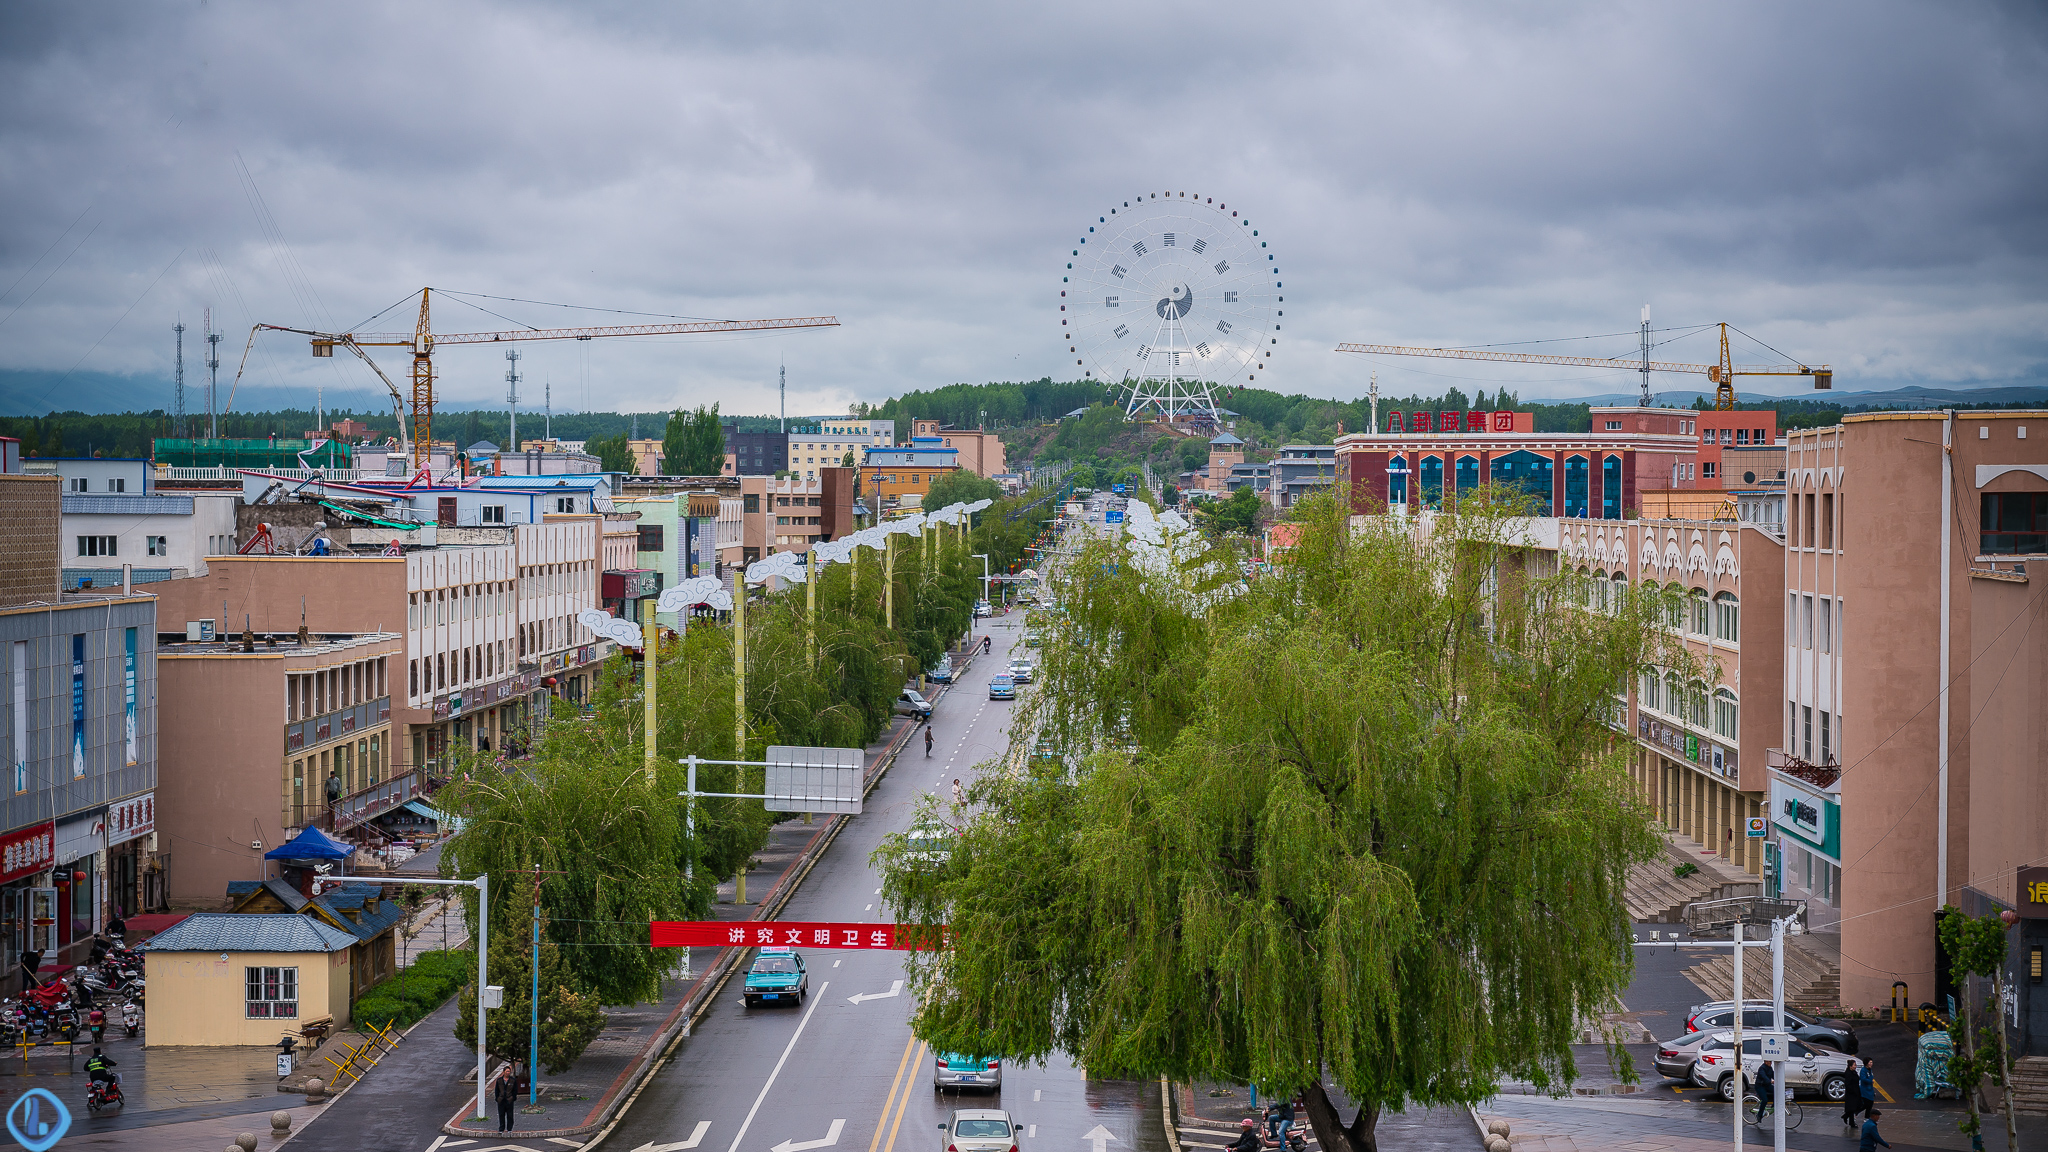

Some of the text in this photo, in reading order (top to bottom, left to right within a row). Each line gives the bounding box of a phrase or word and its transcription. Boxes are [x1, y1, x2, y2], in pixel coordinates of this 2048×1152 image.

[1386, 410, 1514, 432] 八卦城集团
[728, 927, 887, 947] 讲究文明卫生
